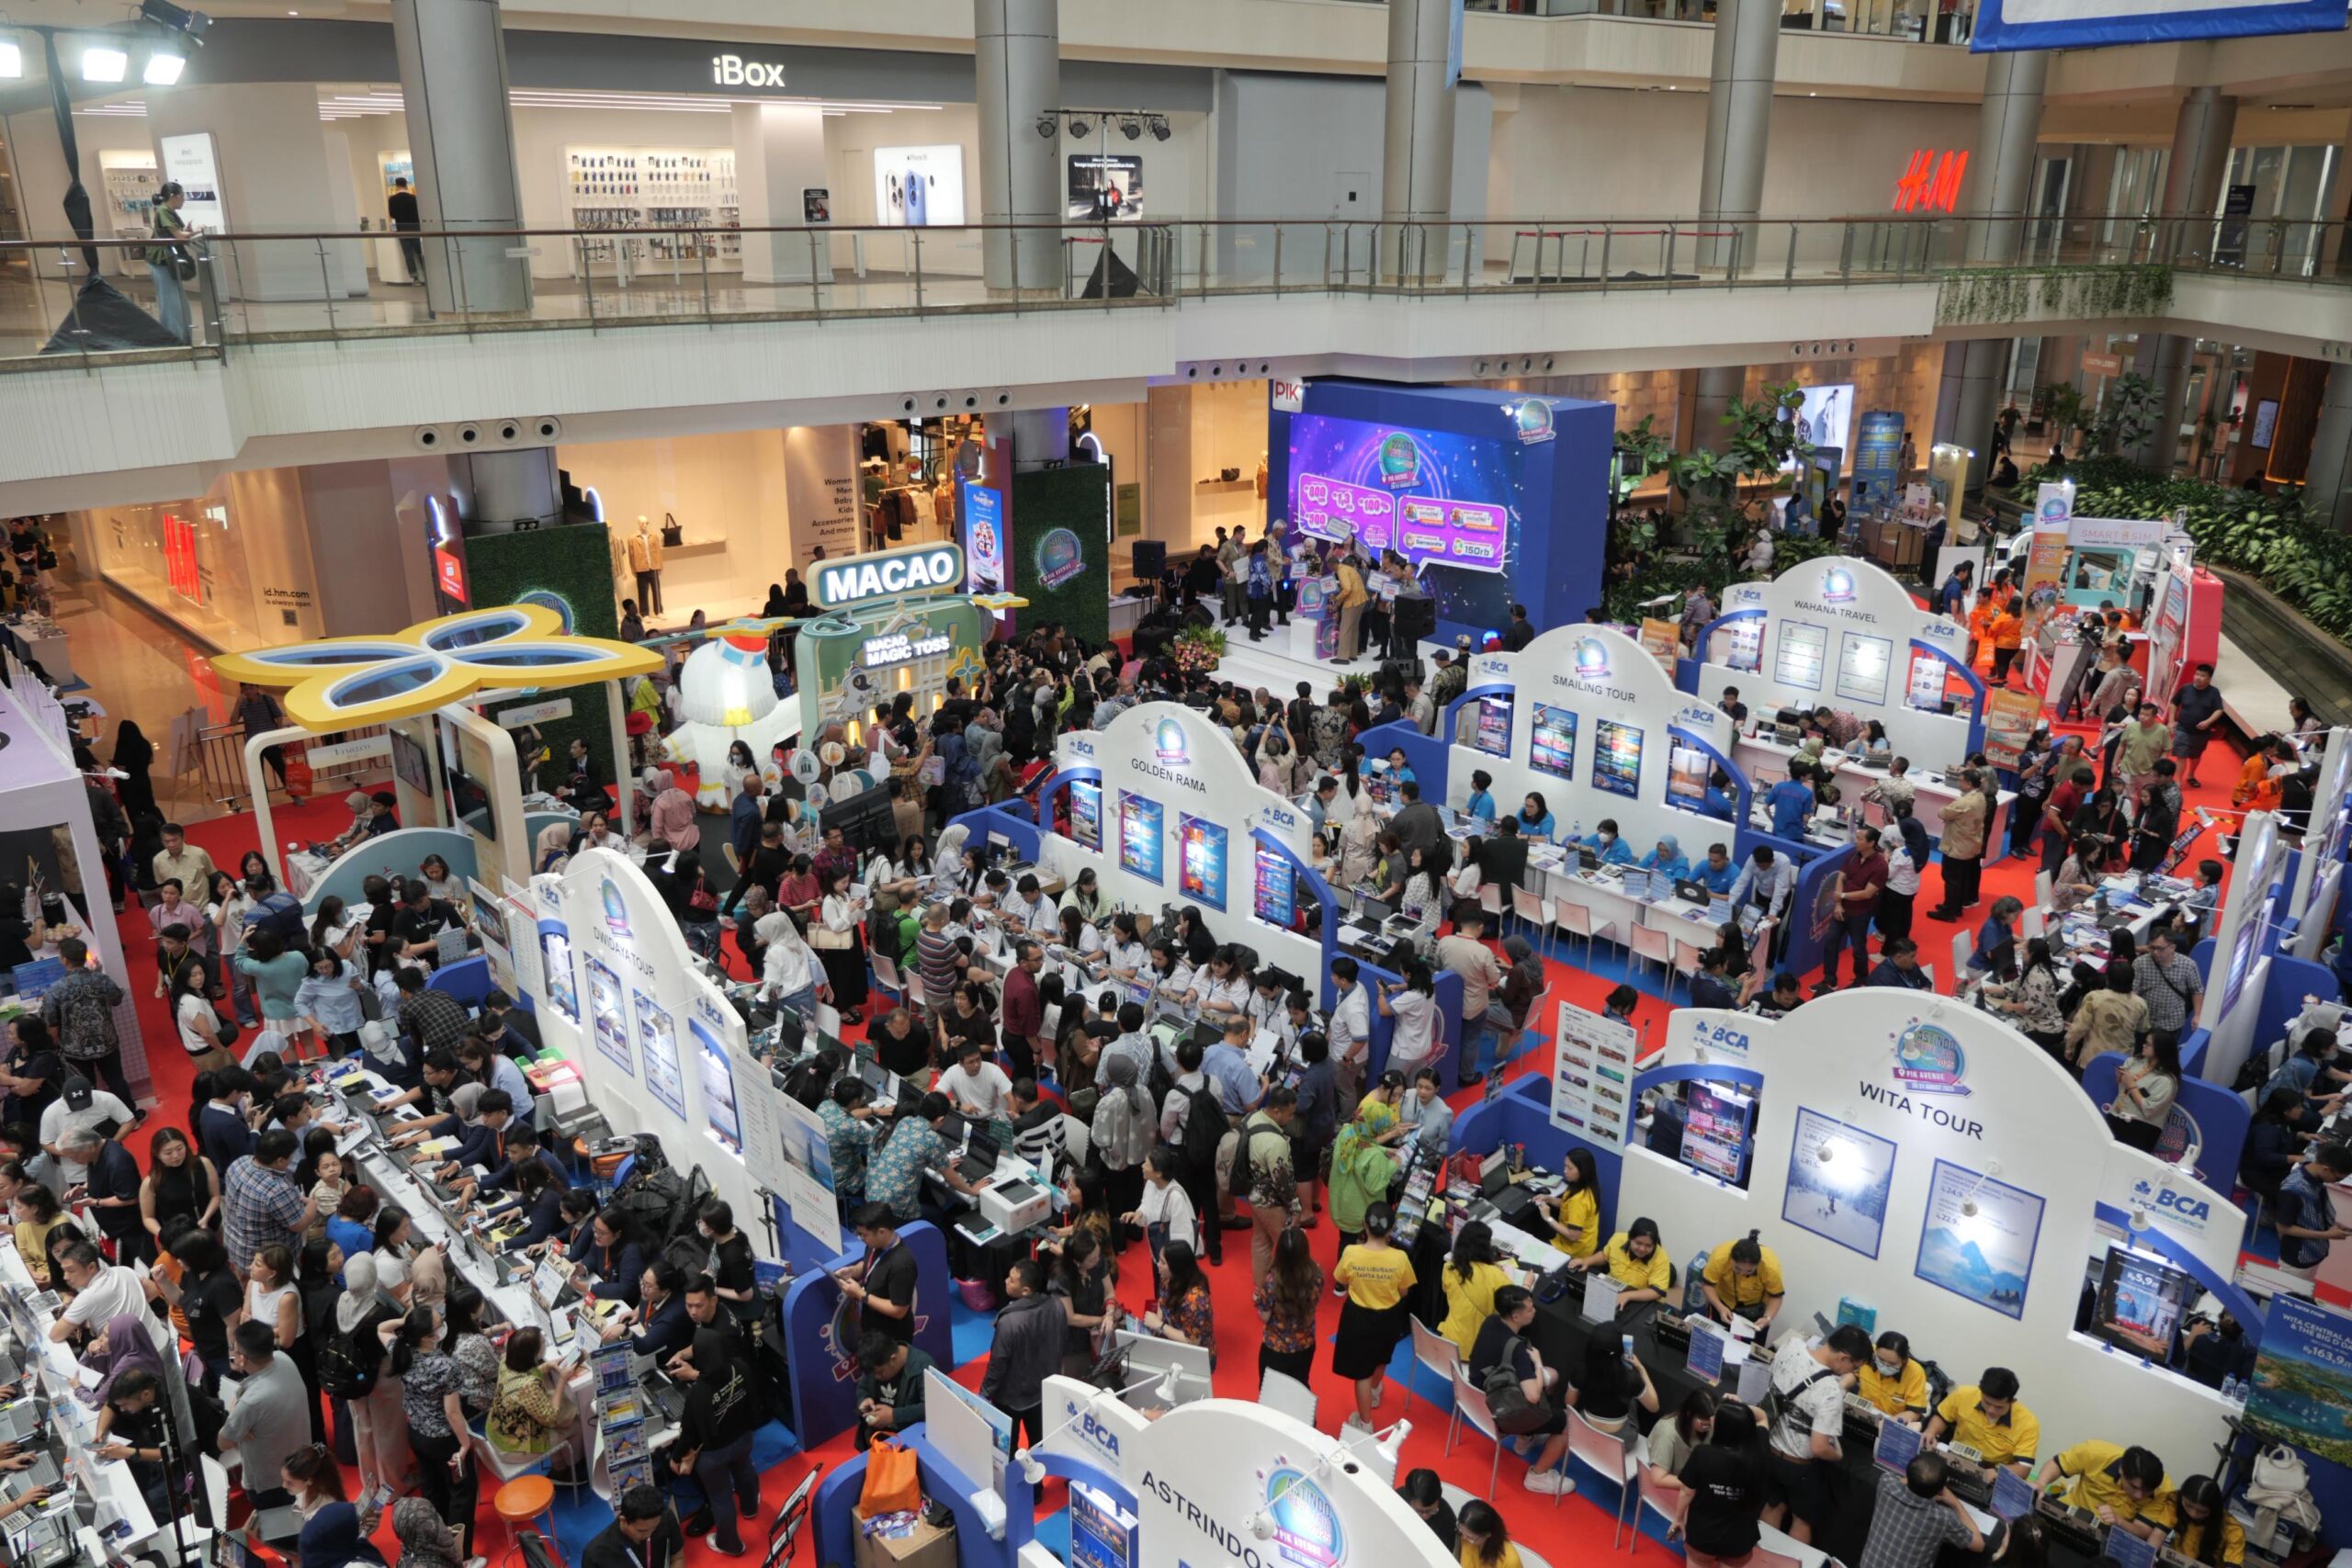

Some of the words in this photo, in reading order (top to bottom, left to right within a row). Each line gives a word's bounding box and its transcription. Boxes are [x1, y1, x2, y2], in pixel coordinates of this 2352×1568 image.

[713, 54, 786, 87] iBox
[1893, 148, 1969, 213] H&M
[1275, 381, 1299, 401] PIK
[834, 497, 853, 505] Baby
[812, 517, 854, 527] Accessories
[820, 527, 835, 536] And
[2081, 529, 2119, 539] SMART
[2132, 530, 2152, 540] SIM
[826, 551, 955, 604] MACAO
[263, 588, 310, 599] id.hm.com
[1794, 600, 1837, 615] WAHANA
[1839, 608, 1878, 624] TRAVEL
[1934, 625, 1955, 637] BCA
[866, 634, 909, 652] MACAO
[866, 645, 912, 667] MAGIC
[1490, 660, 1509, 673] BCA
[1553, 674, 1602, 695] SMAILING
[1606, 686, 1636, 704] TOUR
[1691, 708, 1714, 723] BCA
[1077, 740, 1094, 756] BCA
[1131, 758, 1173, 782] GOLDEN
[1176, 773, 1207, 795] RAMA
[1272, 809, 1295, 827] BCA
[545, 884, 560, 908] BCA
[593, 926, 630, 960] DWIDAYA
[631, 952, 656, 980] TOUR
[705, 998, 725, 1028] BCA
[1712, 1026, 1749, 1052] BCA
[1917, 1030, 1956, 1050] ASTINDO
[1919, 1071, 1945, 1080] AVENUE
[1860, 1080, 1912, 1114] WITA
[1920, 1102, 1983, 1140] TOUR
[2155, 1188, 2210, 1222] BCA
[2282, 1313, 2304, 1326] WITA
[2304, 1322, 2343, 1341] CENTRAL
[2298, 1325, 2314, 1337] THE
[2316, 1332, 2331, 1343] BIG
[1082, 1412, 1120, 1457] BCA
[1141, 1470, 1261, 1568] ASTRINDO
